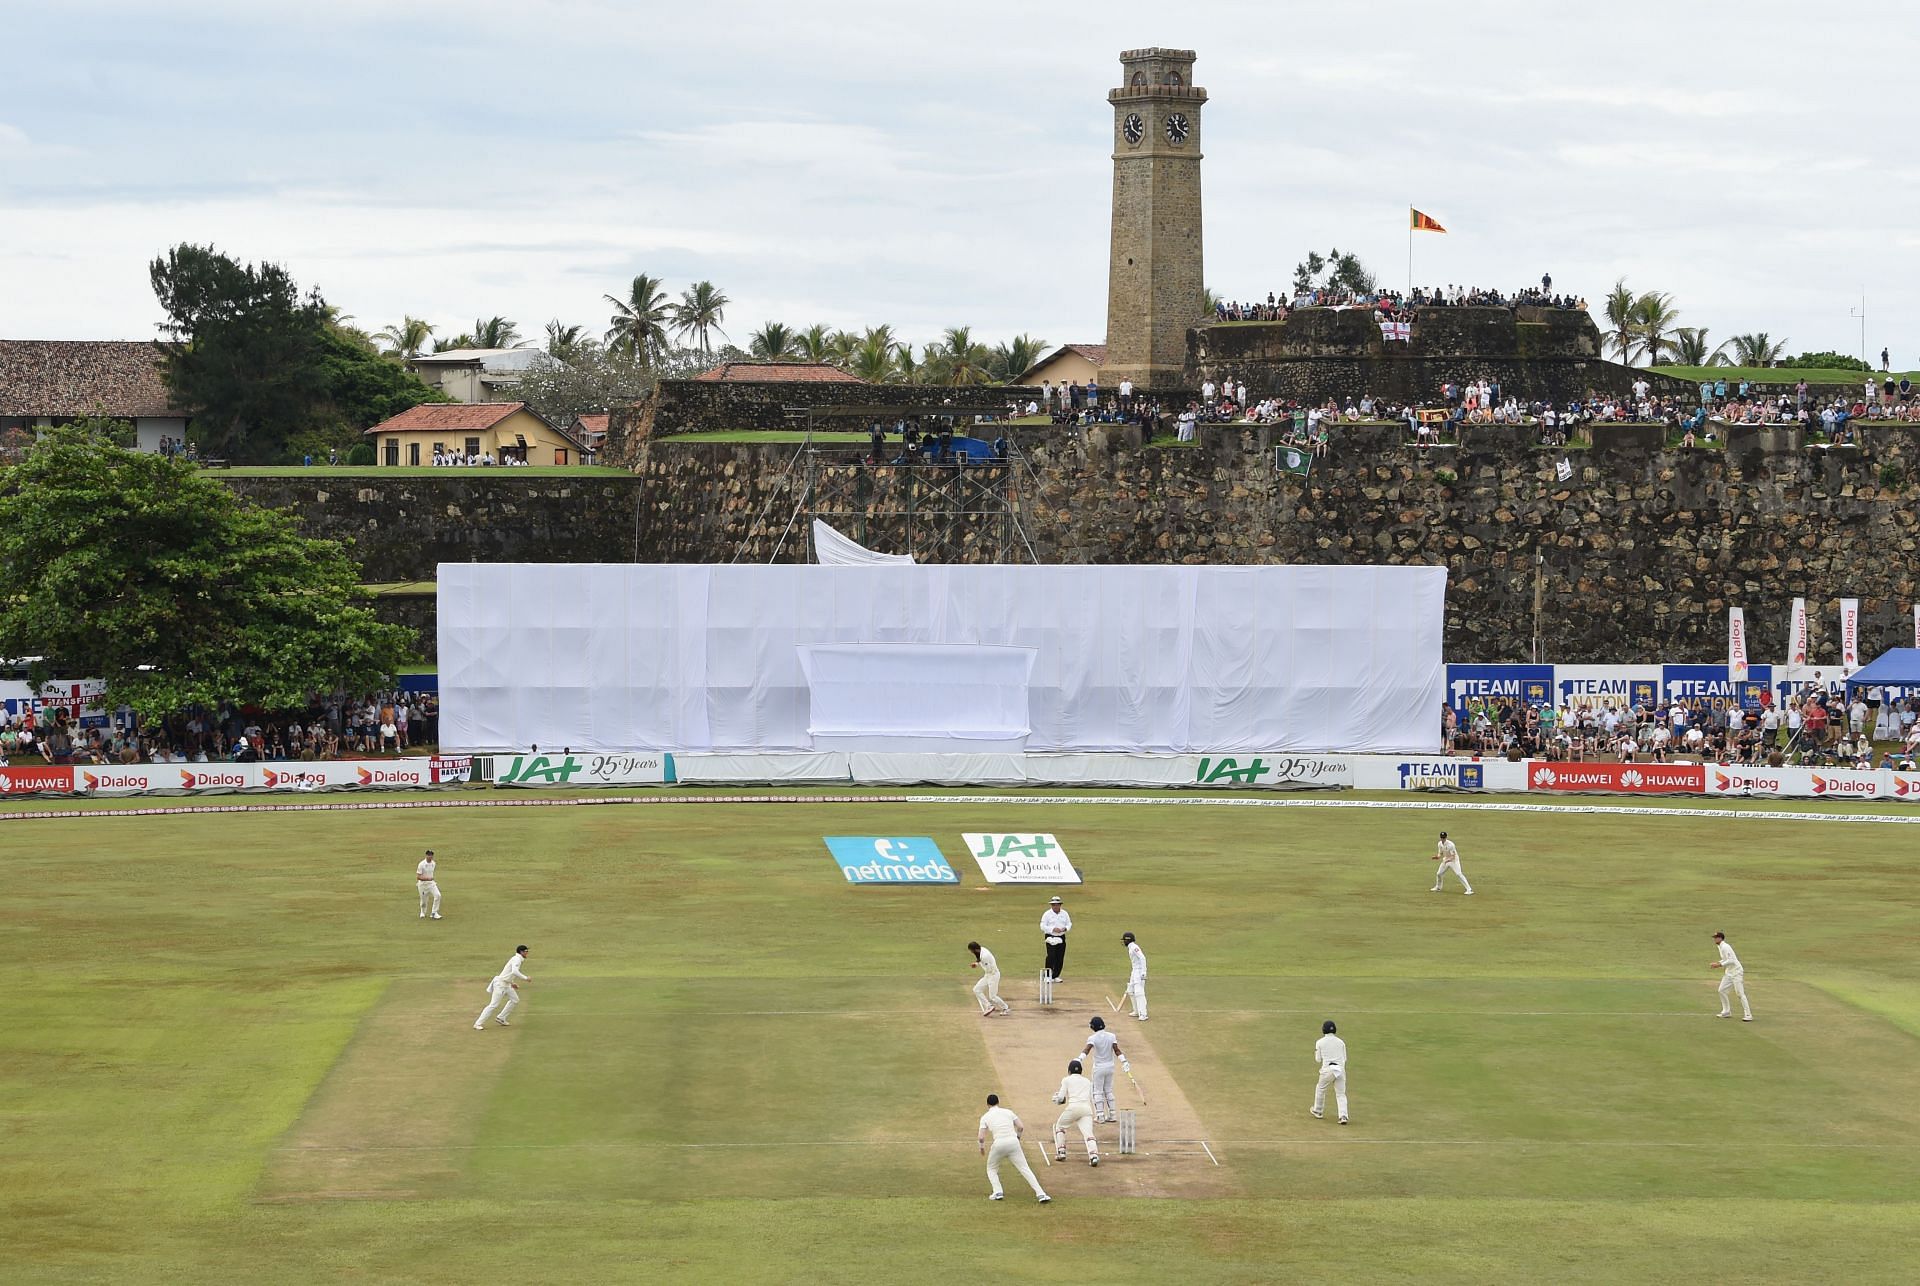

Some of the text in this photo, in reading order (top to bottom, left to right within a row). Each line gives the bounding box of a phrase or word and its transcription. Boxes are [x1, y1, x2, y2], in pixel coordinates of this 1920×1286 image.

[1844, 610, 1855, 649] Dialog
[1732, 619, 1743, 658] Dialog
[46, 685, 67, 697] GUY
[1466, 680, 1519, 695] TEAM
[1574, 680, 1626, 694] TEAM
[1682, 680, 1736, 696] TEAM
[48, 696, 102, 706] MANSFIEL
[375, 769, 419, 784] Dialog
[589, 756, 618, 782] 25
[618, 756, 658, 775] Years
[1277, 758, 1310, 781] 25
[1307, 760, 1347, 778] Years
[1411, 763, 1456, 776] TEAM
[15, 778, 69, 789] HUAWEI
[101, 775, 148, 788] Dialog
[198, 773, 244, 787] Dialog
[1410, 777, 1456, 788] NATION
[1559, 774, 1612, 784] HUAWEI
[1646, 775, 1699, 786] HUAWEI
[1733, 776, 1779, 791] Dalog
[1829, 779, 1876, 794] Dialog
[843, 859, 955, 881] netmeds
[996, 860, 1018, 875] 25
[1018, 861, 1052, 875] Years
